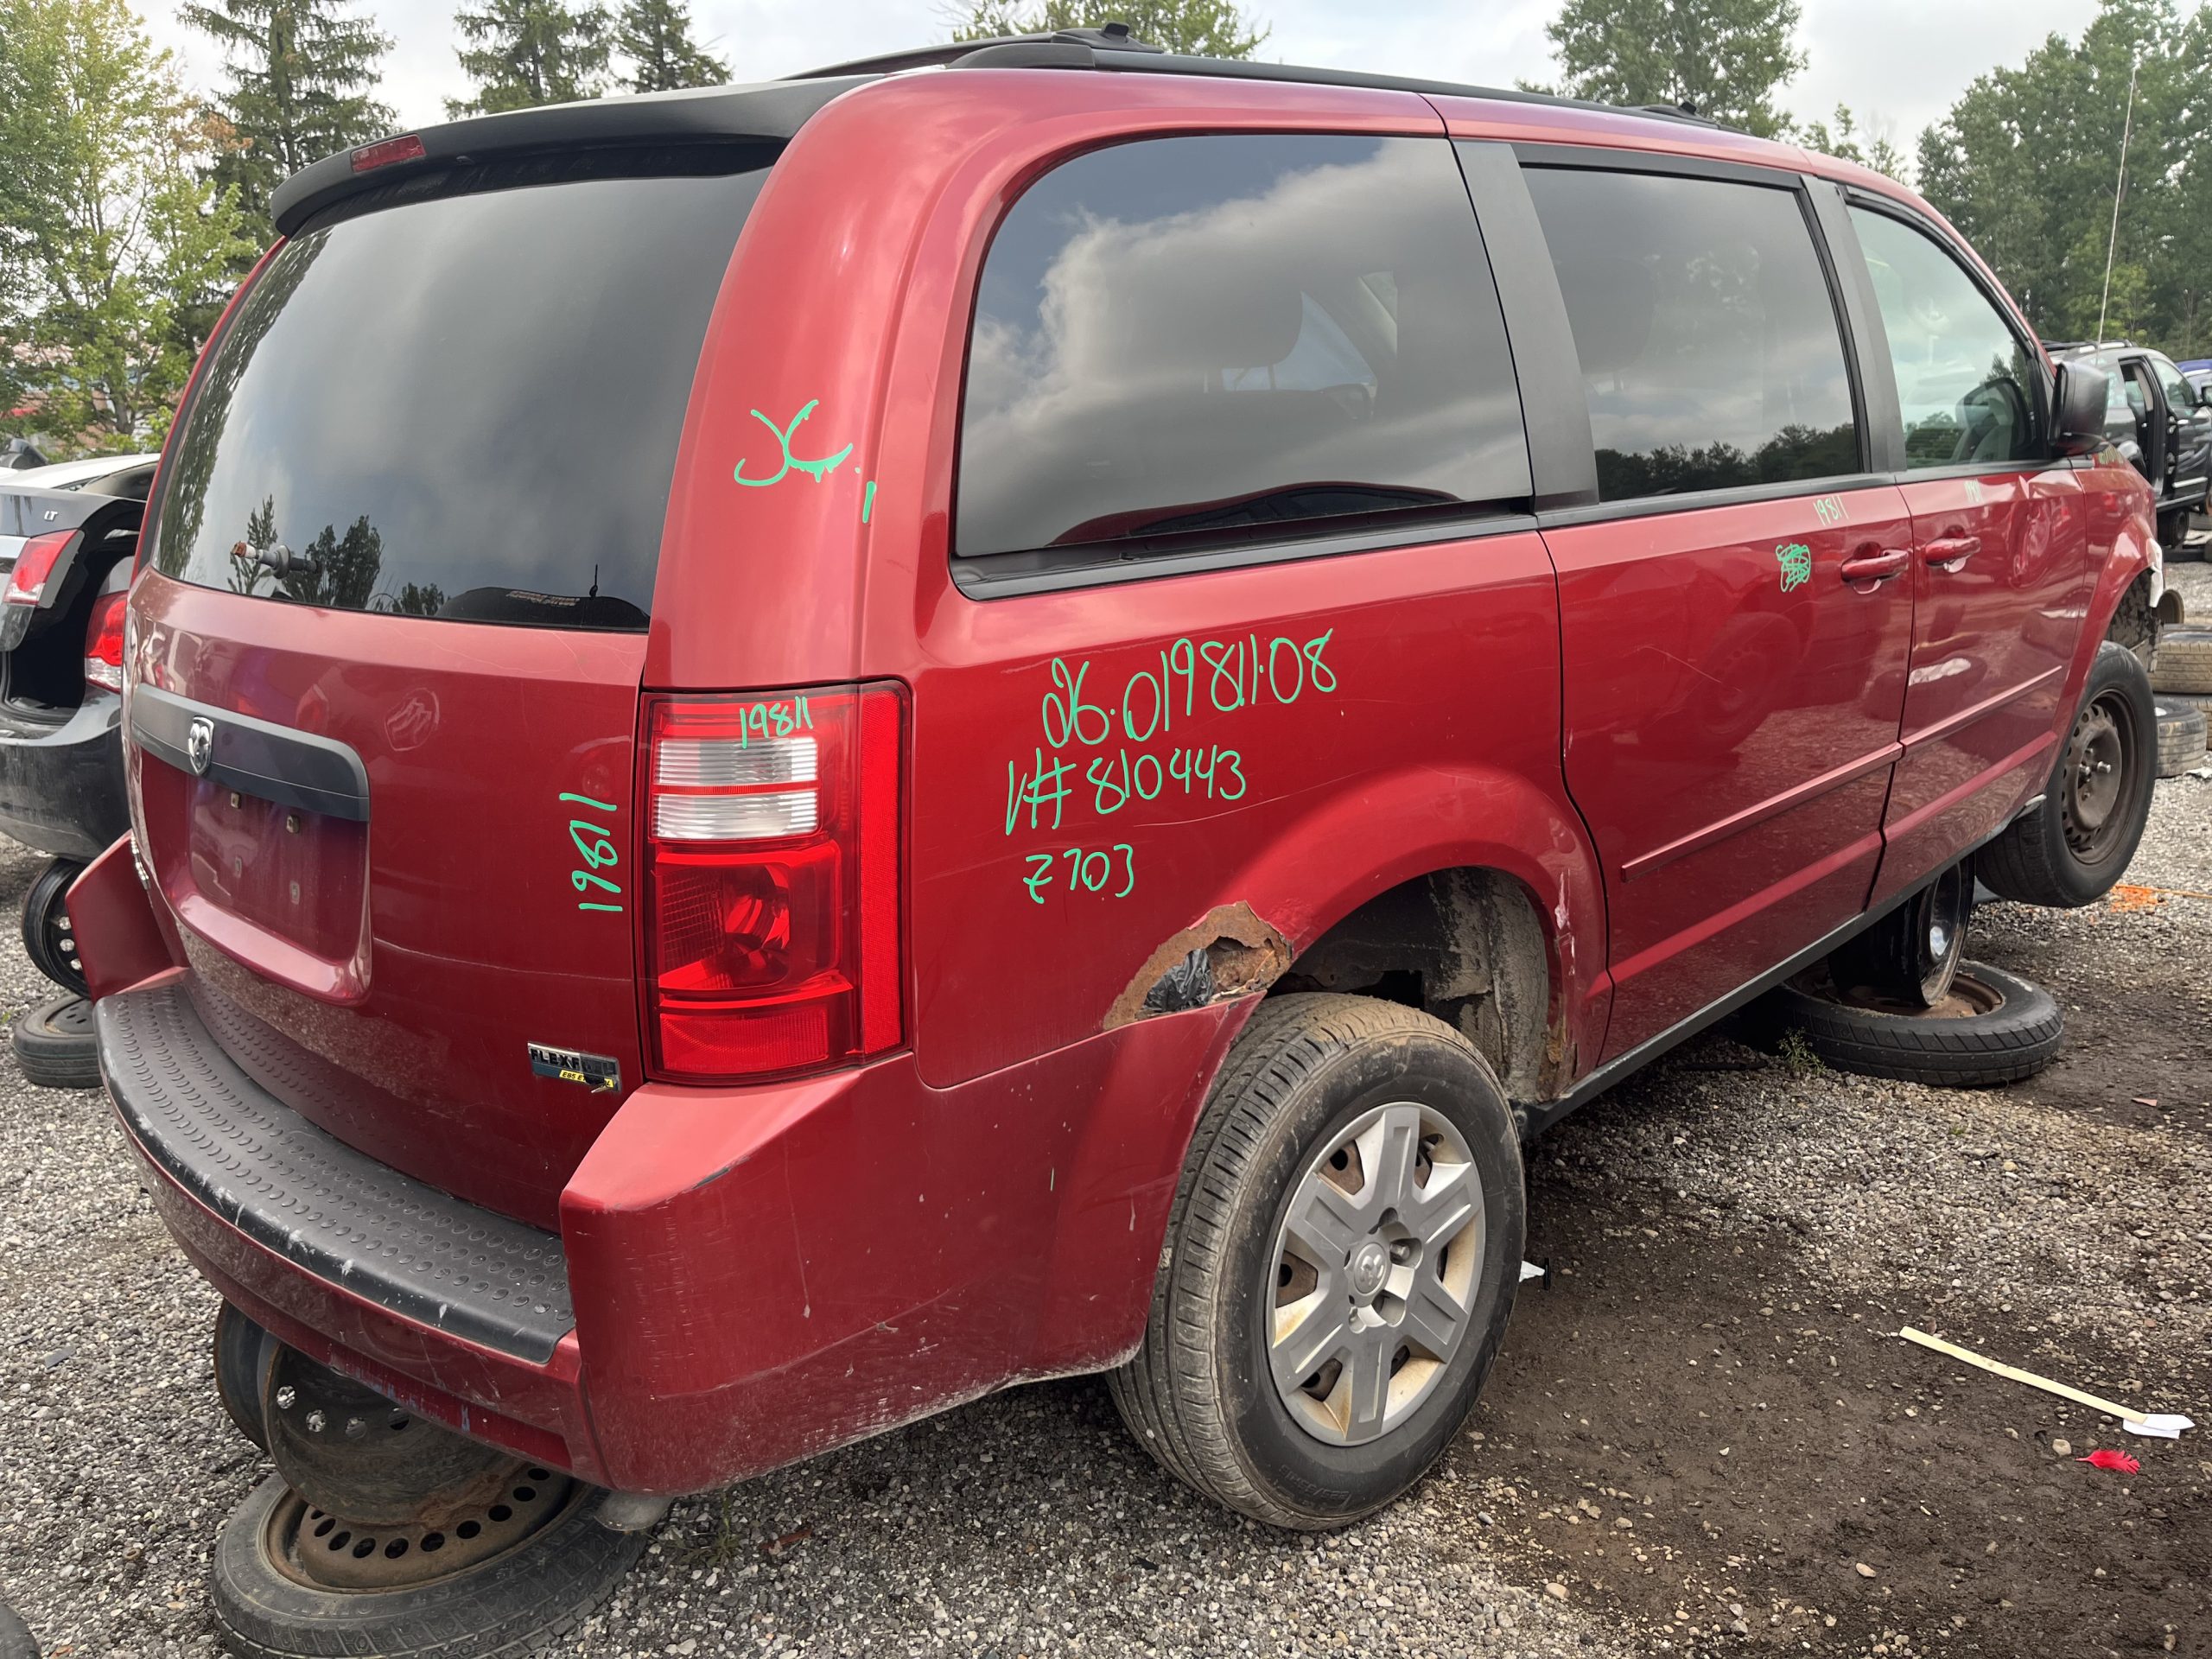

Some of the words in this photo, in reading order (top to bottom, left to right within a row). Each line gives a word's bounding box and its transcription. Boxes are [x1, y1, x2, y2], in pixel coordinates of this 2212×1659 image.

[1813, 495, 1849, 526] 19811
[740, 696, 813, 749] 19811
[559, 792, 623, 912] 19811
